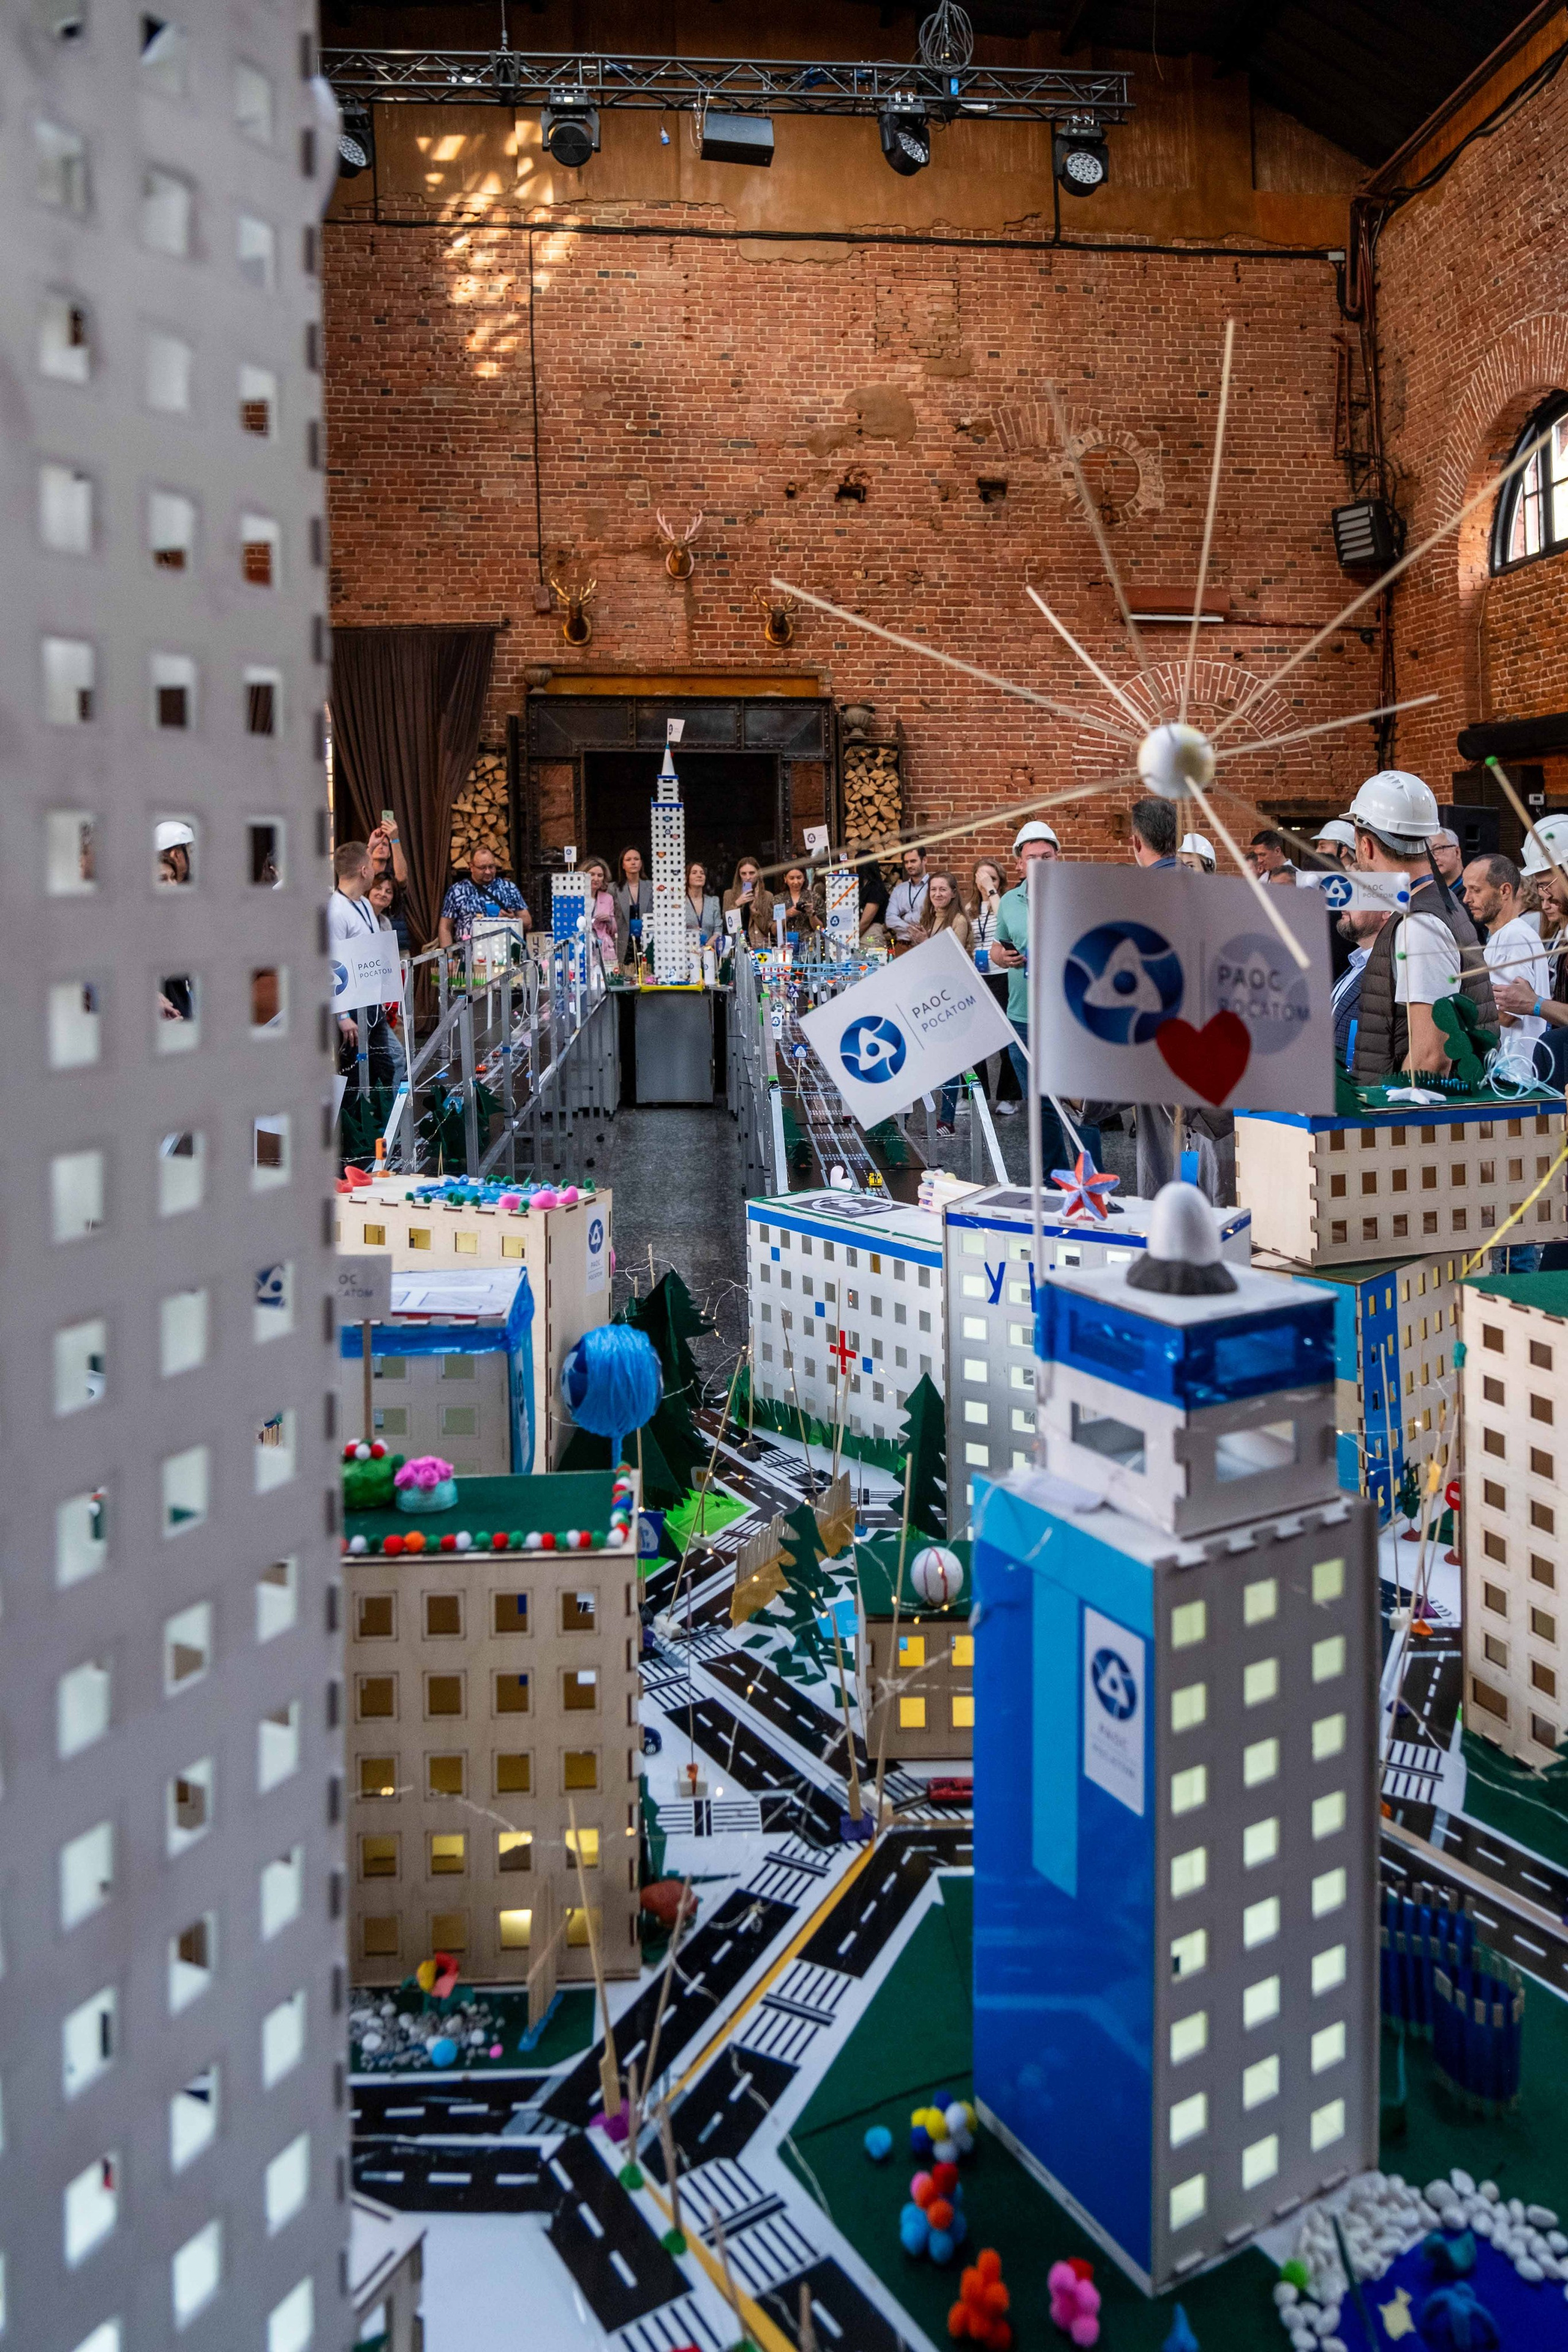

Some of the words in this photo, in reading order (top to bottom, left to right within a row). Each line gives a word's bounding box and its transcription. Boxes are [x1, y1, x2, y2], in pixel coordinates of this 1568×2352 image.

[358, 960, 381, 970] РАОС
[360, 968, 393, 978] РОСАТОМ
[1218, 964, 1281, 992] РАОС
[912, 989, 951, 1019] РАОС
[921, 995, 976, 1032] РОСАТОМ
